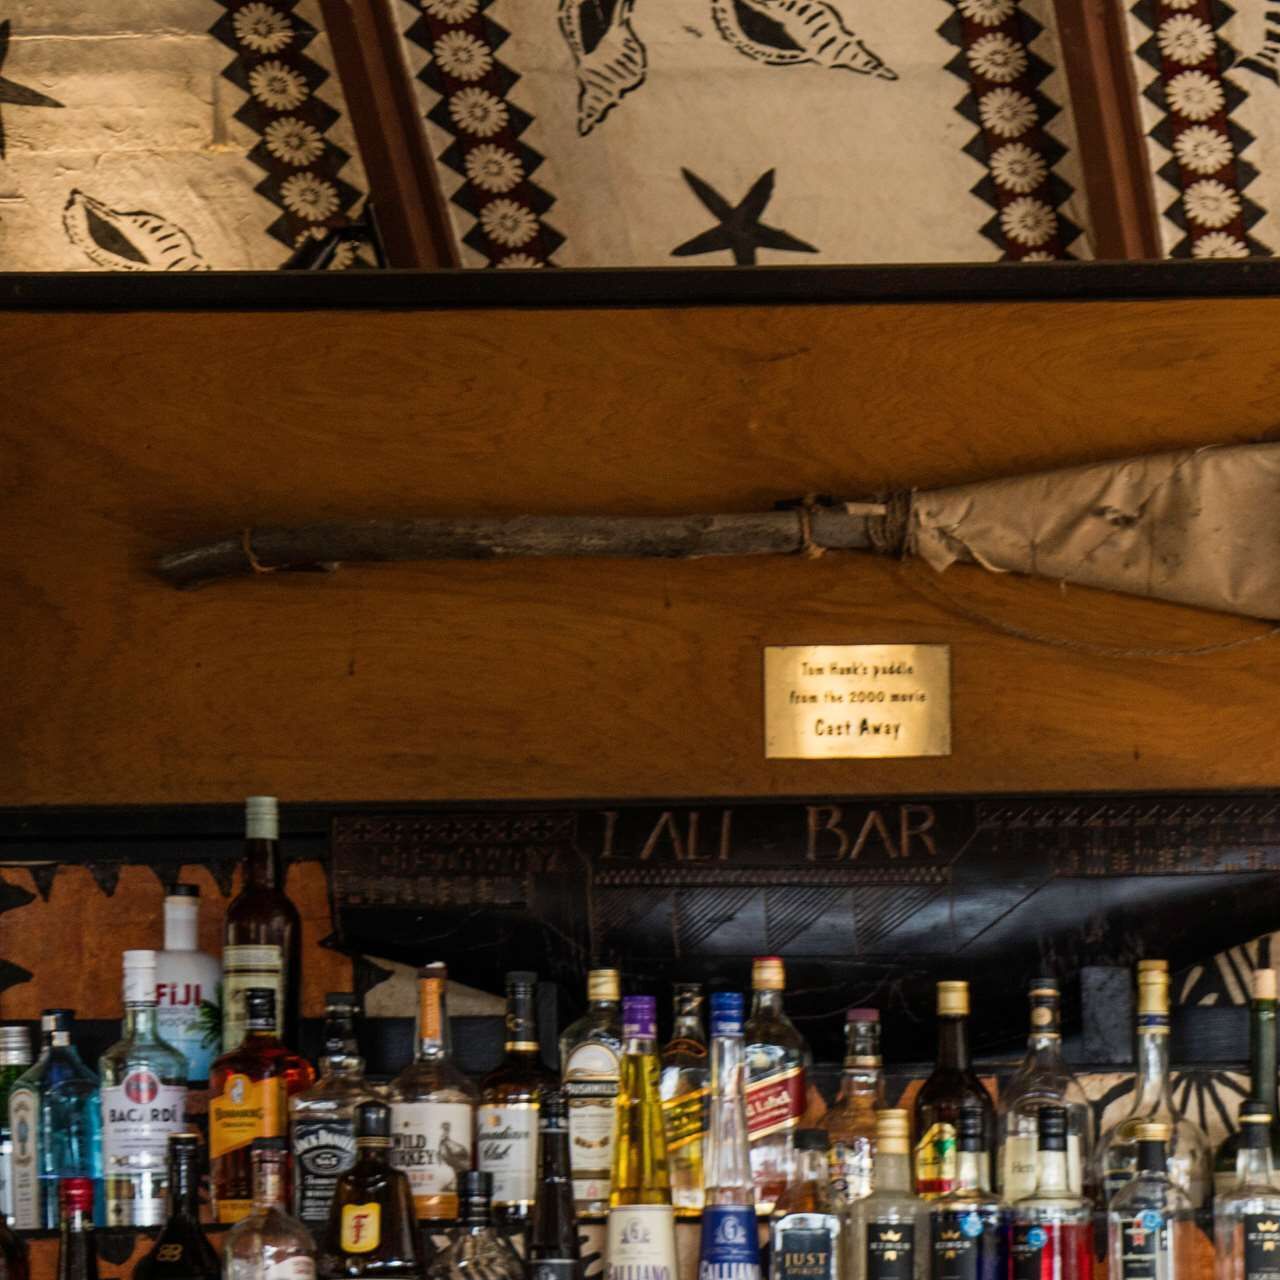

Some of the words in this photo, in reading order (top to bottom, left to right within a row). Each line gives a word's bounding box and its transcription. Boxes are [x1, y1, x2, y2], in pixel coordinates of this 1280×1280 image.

[801, 662, 824, 676] Tom
[829, 661, 868, 676] Hank's
[872, 662, 914, 679] paddle
[788, 690, 818, 704] from
[824, 690, 843, 704] the
[849, 691, 886, 704] 2000
[890, 691, 927, 704] movie
[814, 718, 851, 736] Cast
[859, 718, 901, 739] Away
[804, 803, 938, 863] BAR
[391, 1149, 435, 1167] URKEY
[784, 1251, 828, 1267] JUST
